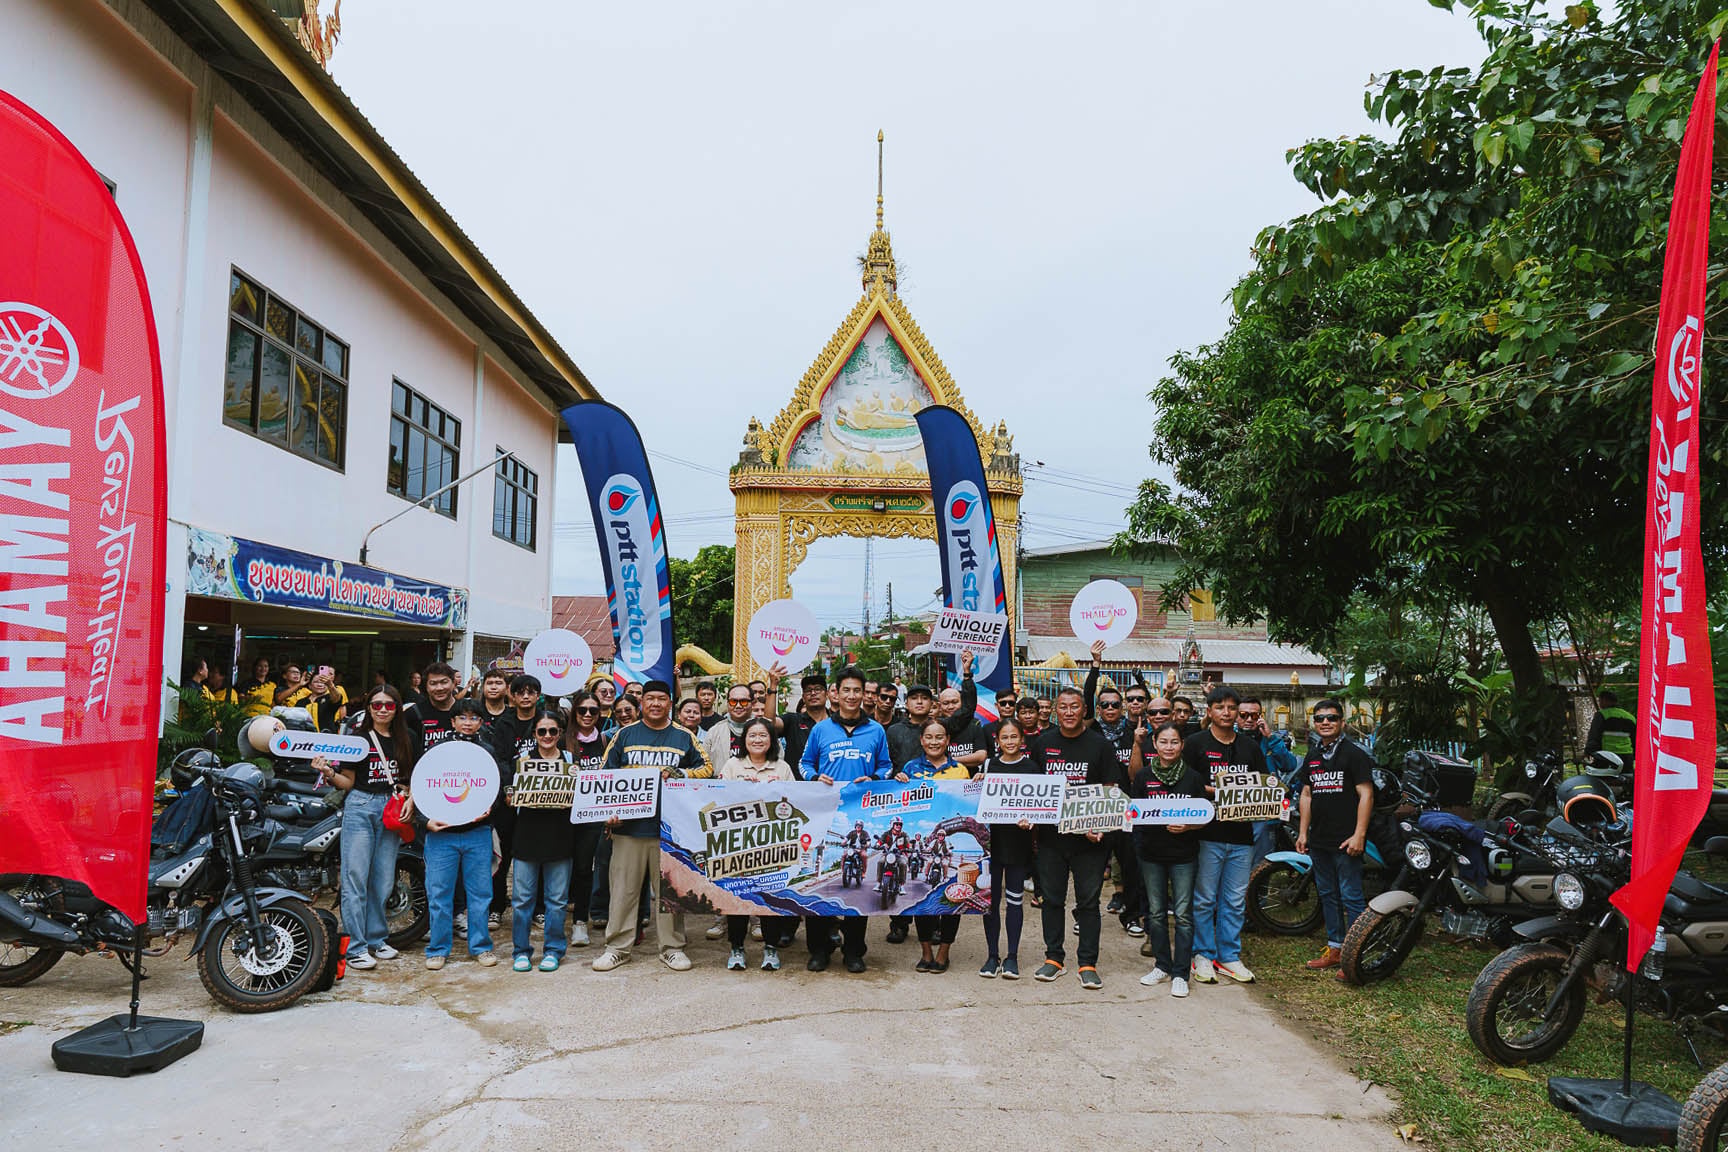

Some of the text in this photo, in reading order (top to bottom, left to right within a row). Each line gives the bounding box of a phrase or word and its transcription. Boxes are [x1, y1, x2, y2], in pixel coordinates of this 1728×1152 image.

[1080, 608, 1127, 620] THAILAND
[940, 617, 1002, 635] UNIQUE
[760, 630, 809, 645] THAILAND
[951, 631, 999, 643] PERIENCE
[536, 658, 583, 667] THAILAND
[627, 751, 680, 767] YAMAHA
[828, 748, 872, 763] PG-1
[524, 761, 560, 773] PG-1
[1046, 762, 1089, 771] UNIQUE
[426, 778, 487, 788] THAILAND
[516, 775, 577, 791] MEKON
[580, 777, 654, 795] UNIQUE
[1222, 774, 1259, 787] PG-1
[516, 792, 575, 805] PLAYGROUN
[595, 792, 653, 805] PERIENCE
[986, 784, 1061, 798] UNIQUE
[1065, 786, 1101, 799] PG-1
[1218, 788, 1283, 806] MEKONG
[1000, 799, 1059, 808] PERIENCE
[1061, 800, 1125, 819] MEKONG
[710, 803, 764, 828] PG-1
[1221, 804, 1281, 819] PLAYGROUND
[1063, 815, 1123, 832] PLAYGROUND
[706, 819, 800, 858] MEKONG
[712, 843, 798, 878] PLAYGROUND
